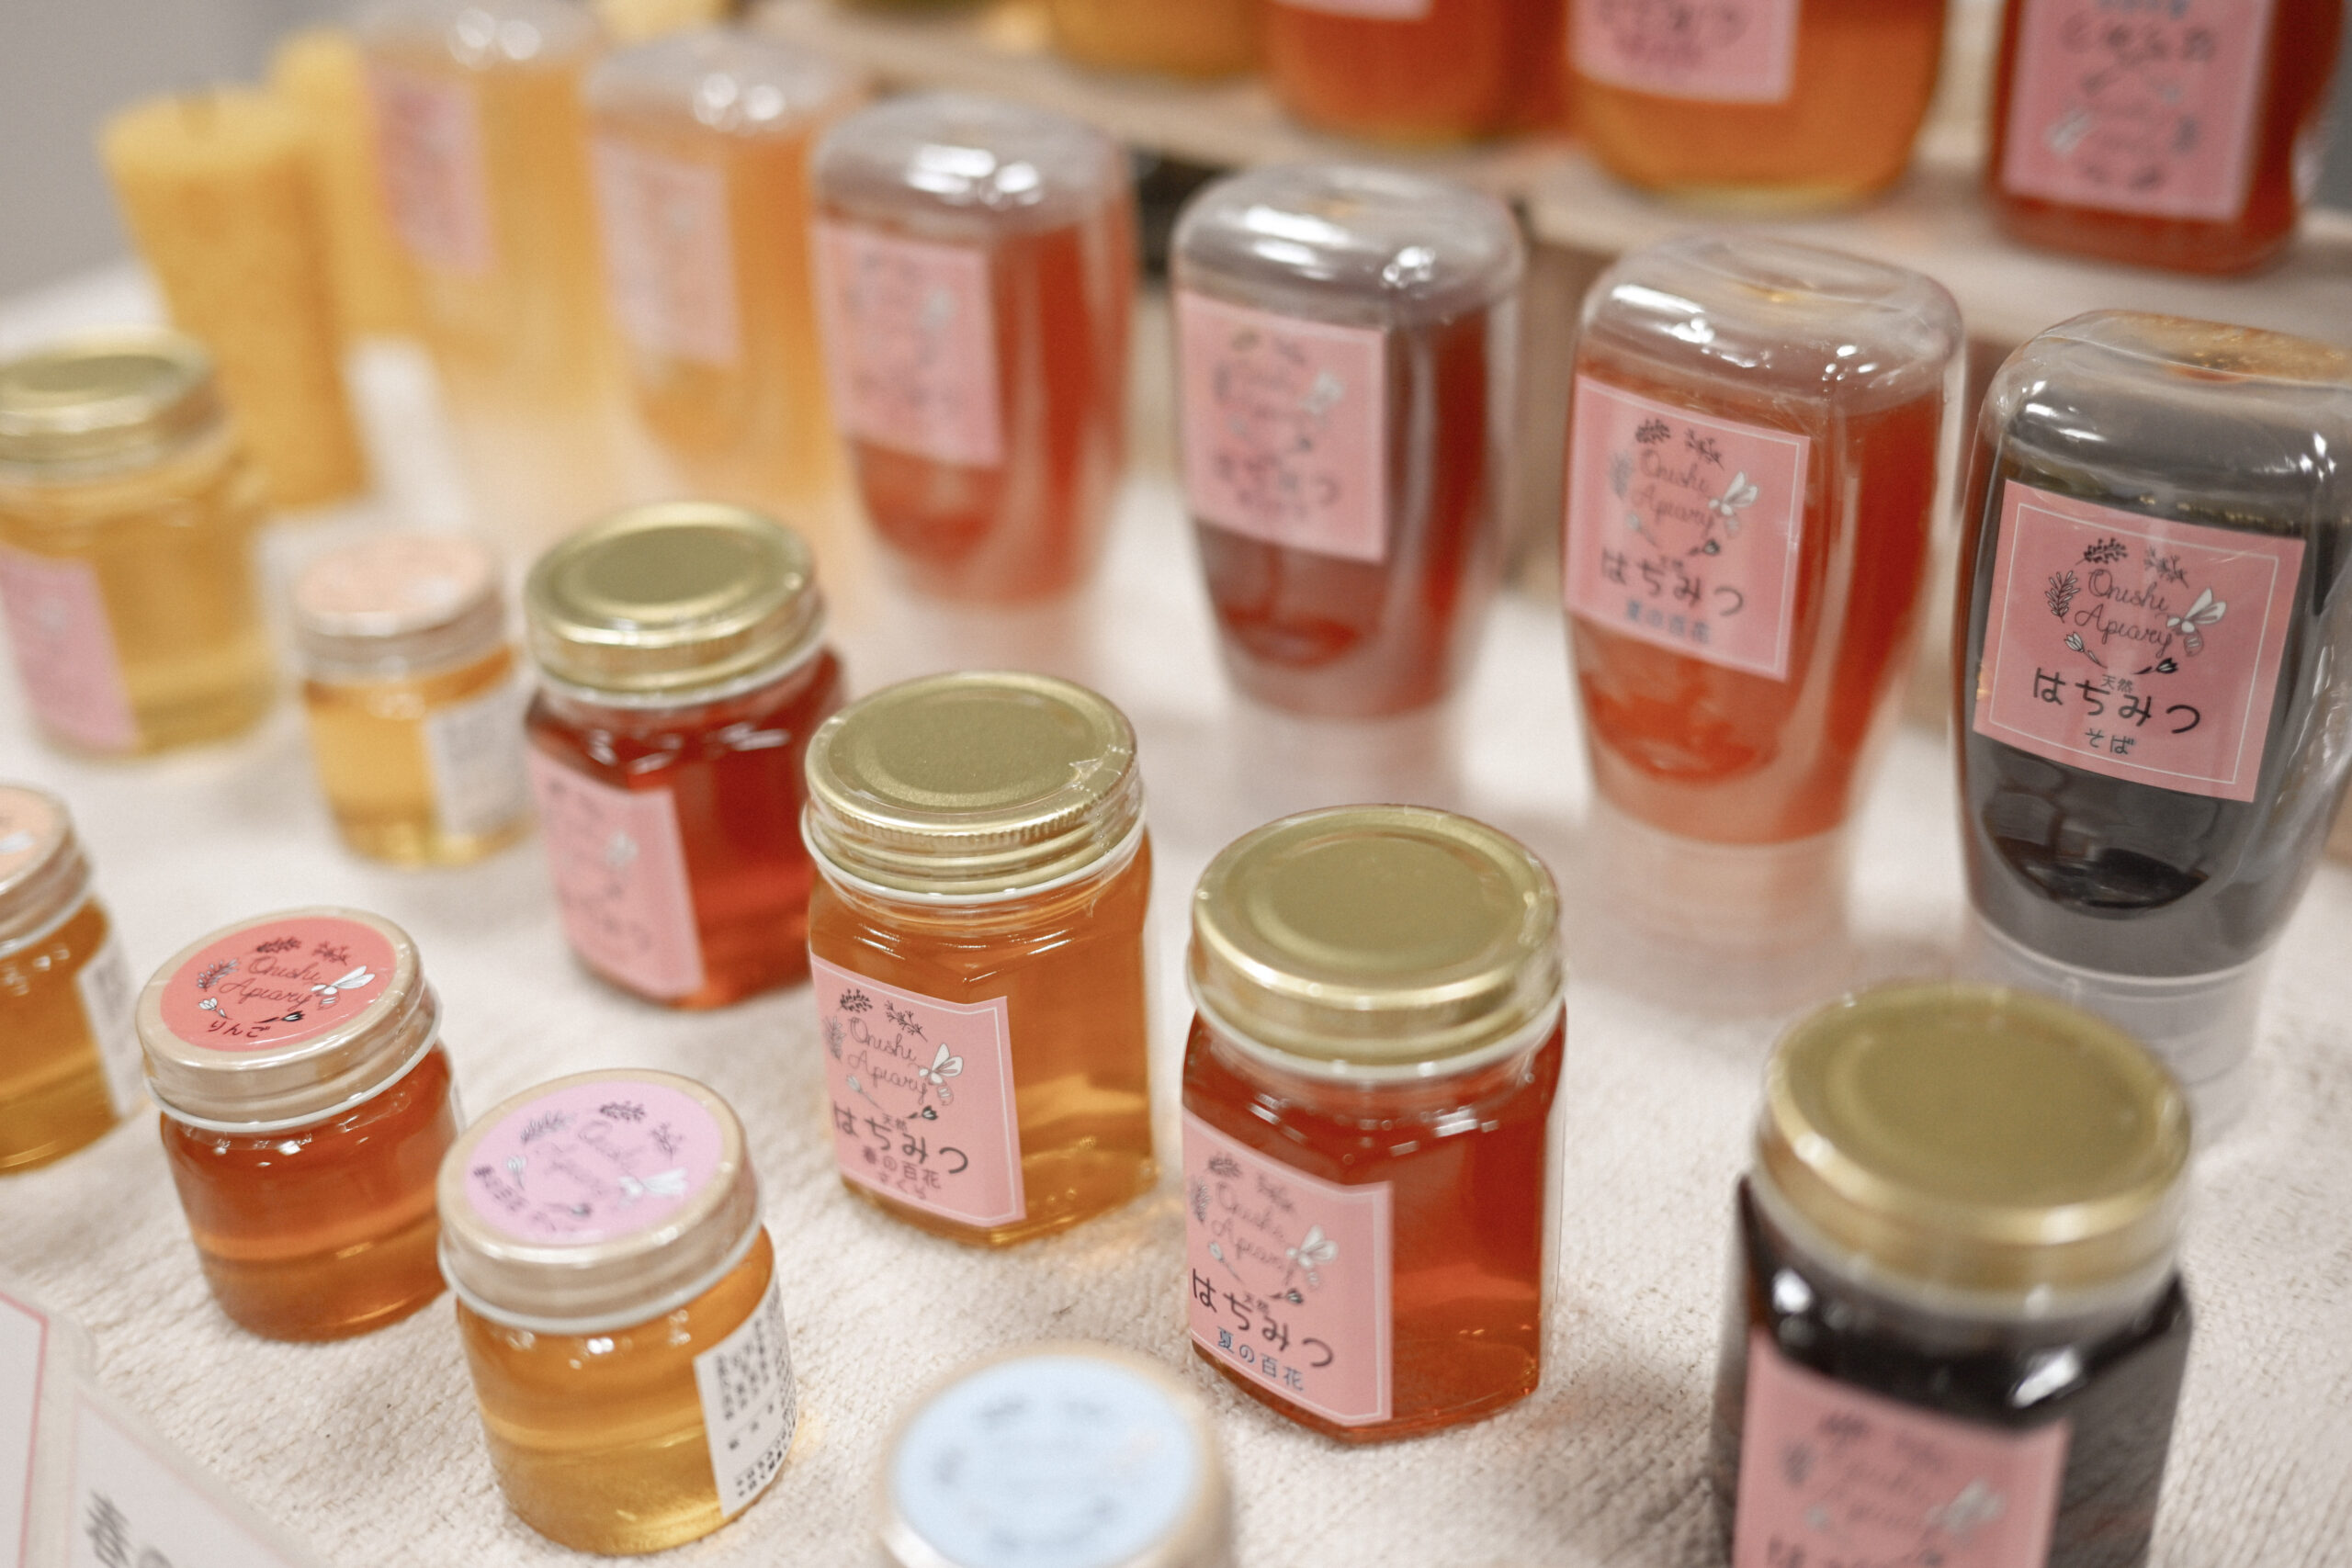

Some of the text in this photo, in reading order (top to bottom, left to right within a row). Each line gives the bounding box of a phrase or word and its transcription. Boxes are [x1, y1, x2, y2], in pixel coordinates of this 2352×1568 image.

[1601, 547, 1744, 616] はちみつ
[2087, 569, 2168, 613] Onishi
[2075, 604, 2173, 658] Apiary
[2034, 667, 2201, 734] はちみつ
[2101, 673, 2133, 694] 天然
[2086, 728, 2137, 755] そば
[220, 977, 314, 1010] Apiary
[249, 956, 322, 983] Onishi
[208, 1021, 271, 1038] りんご
[848, 1017, 917, 1063] Onishi
[848, 1051, 928, 1105] Apiary
[834, 1101, 968, 1174] はちみつ
[1193, 1269, 1334, 1368] はちみつ
[1217, 1326, 1305, 1392] 夏の百花
